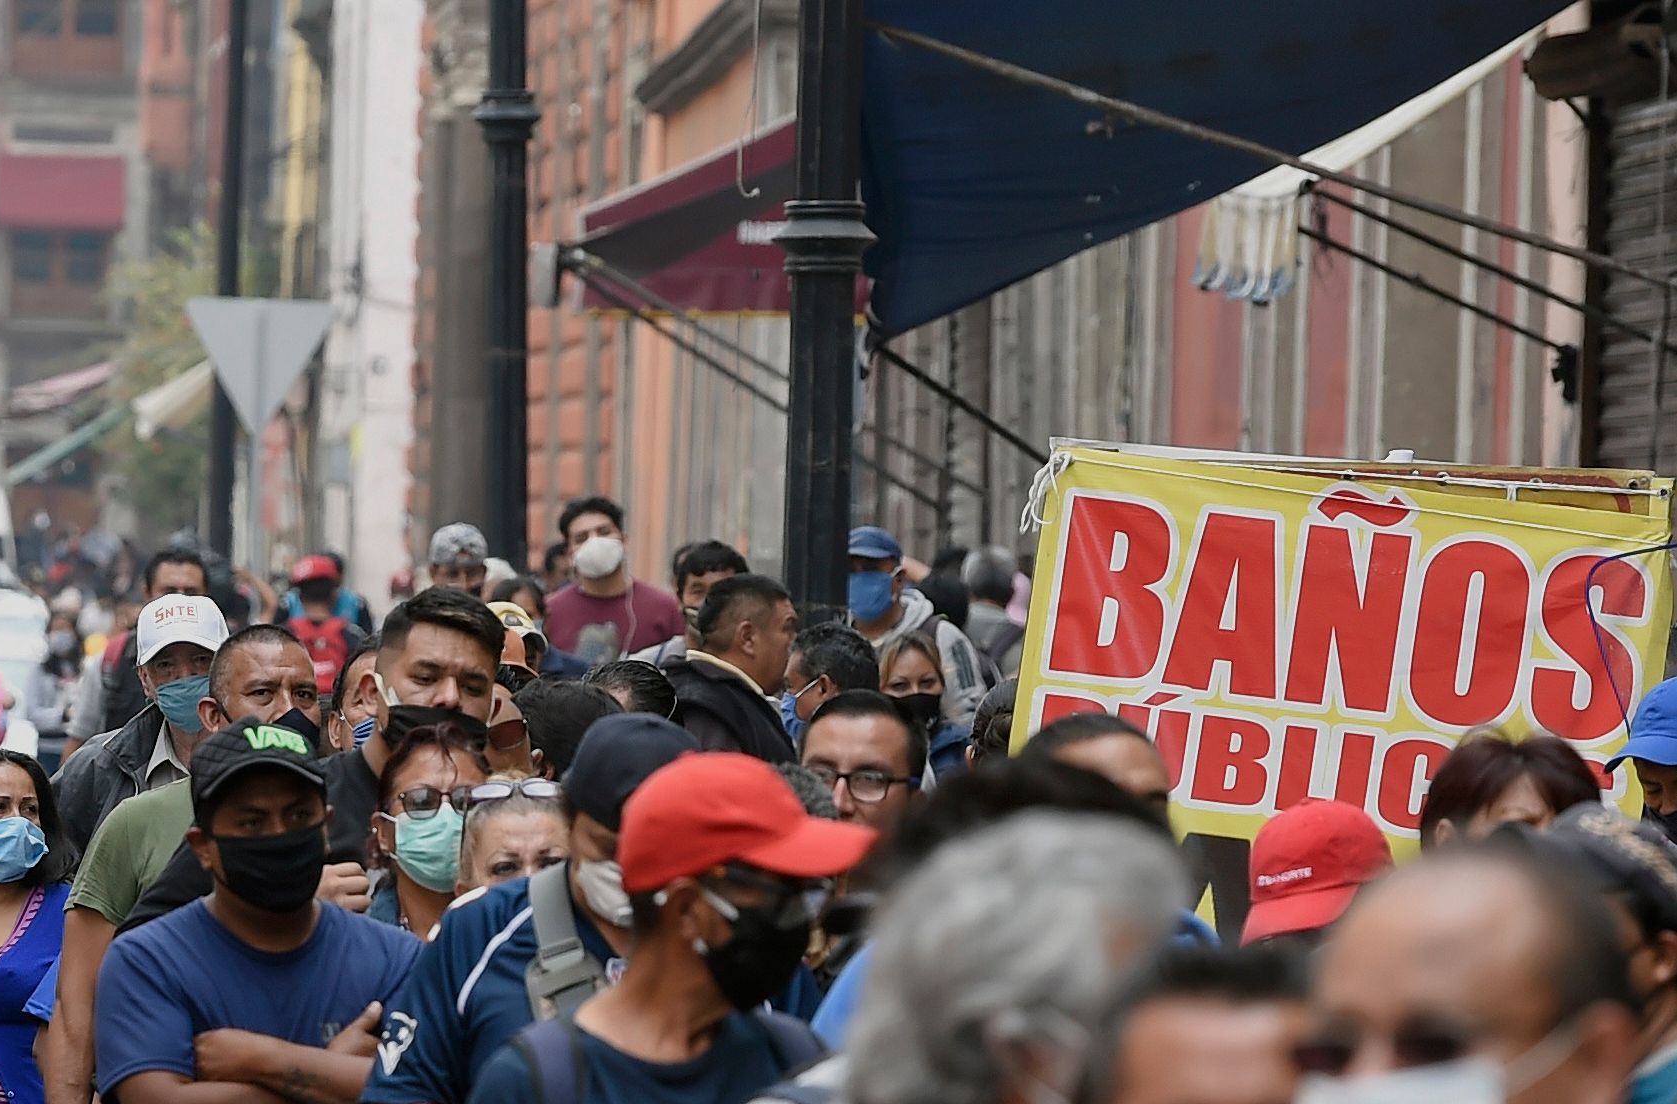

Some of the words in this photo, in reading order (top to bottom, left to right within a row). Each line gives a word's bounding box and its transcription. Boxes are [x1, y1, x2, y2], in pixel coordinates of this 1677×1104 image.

[154, 605, 196, 624] SNTE
[1046, 487, 1648, 742] BAÑOS
[1039, 690, 1615, 832] ÚBLIC
